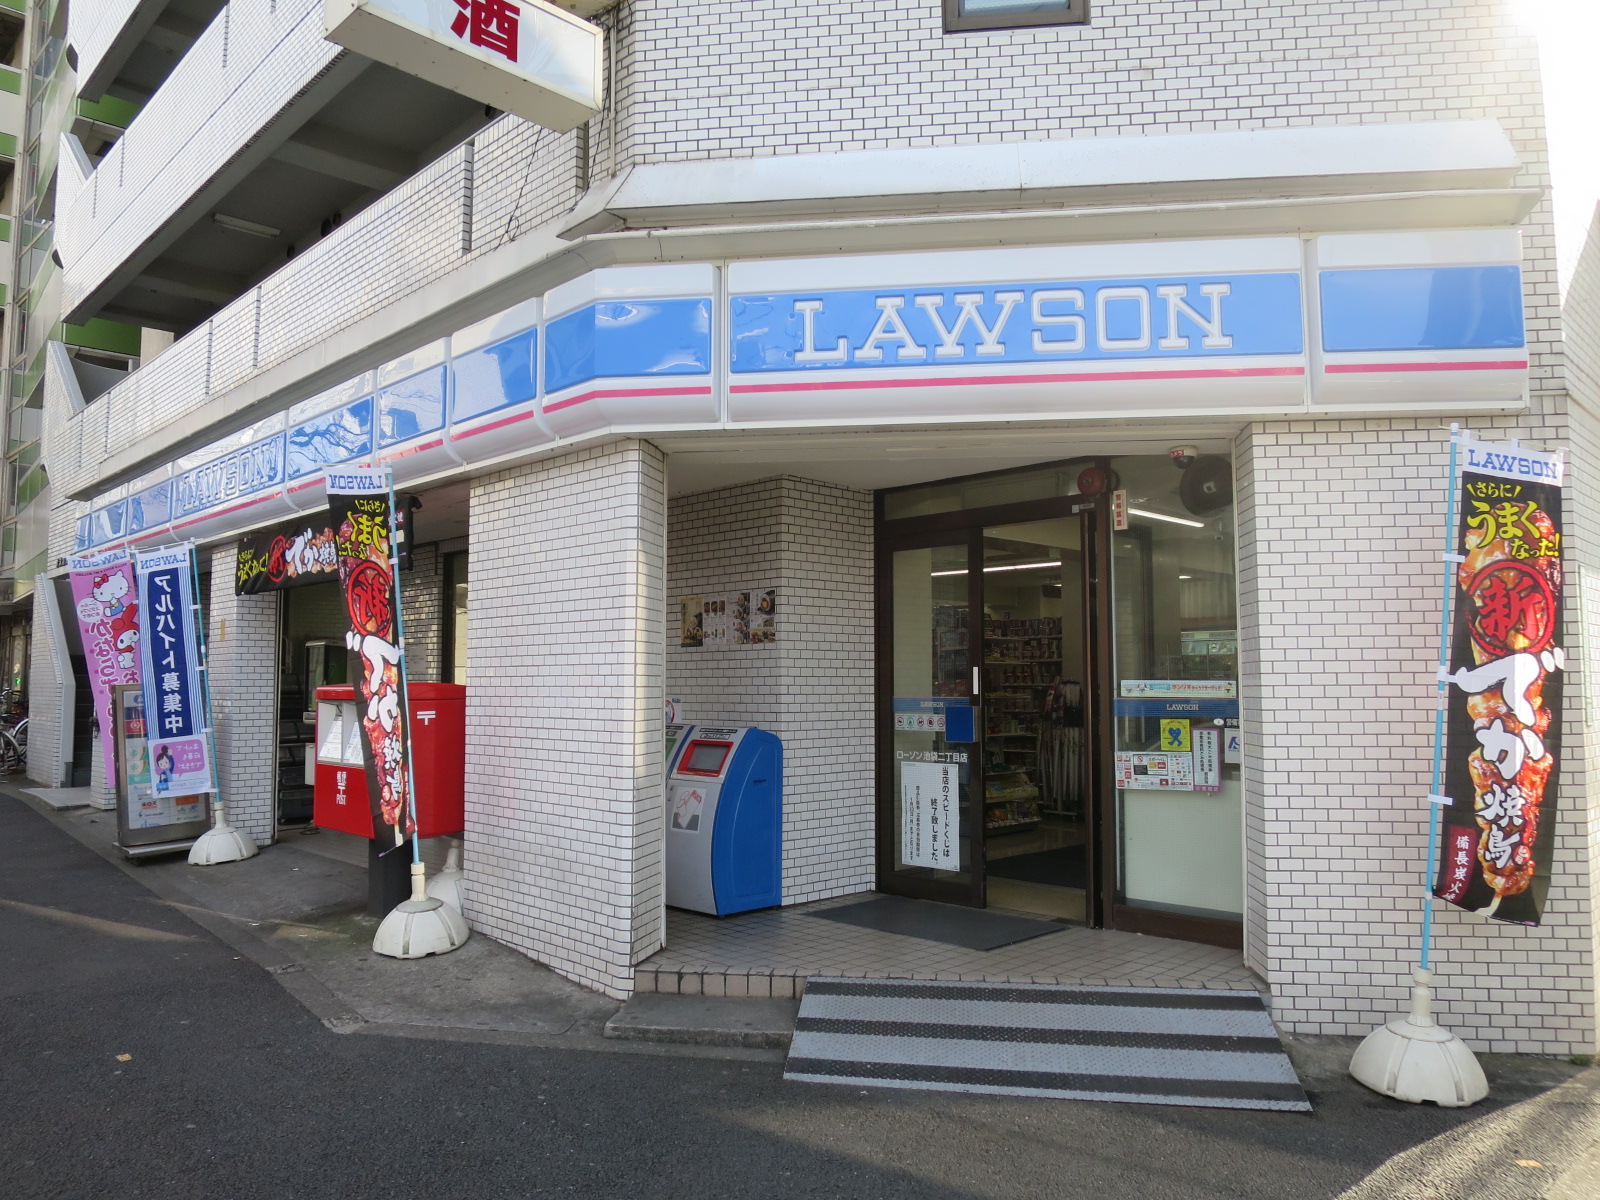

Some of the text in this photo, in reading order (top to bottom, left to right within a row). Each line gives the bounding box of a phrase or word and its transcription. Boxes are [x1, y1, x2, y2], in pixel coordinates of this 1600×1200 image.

[450, 0, 521, 63] 酒
[794, 282, 1233, 362] LAWSON
[181, 442, 272, 511] LAWSON
[1468, 448, 1558, 480] LAWSON
[1466, 500, 1541, 548] うまく
[1479, 575, 1543, 643] 新
[1166, 703, 1199, 711] LAWSON
[896, 750, 968, 763] ローソン池袋二丁目店
[941, 767, 950, 858] 当店のスピードくじは
